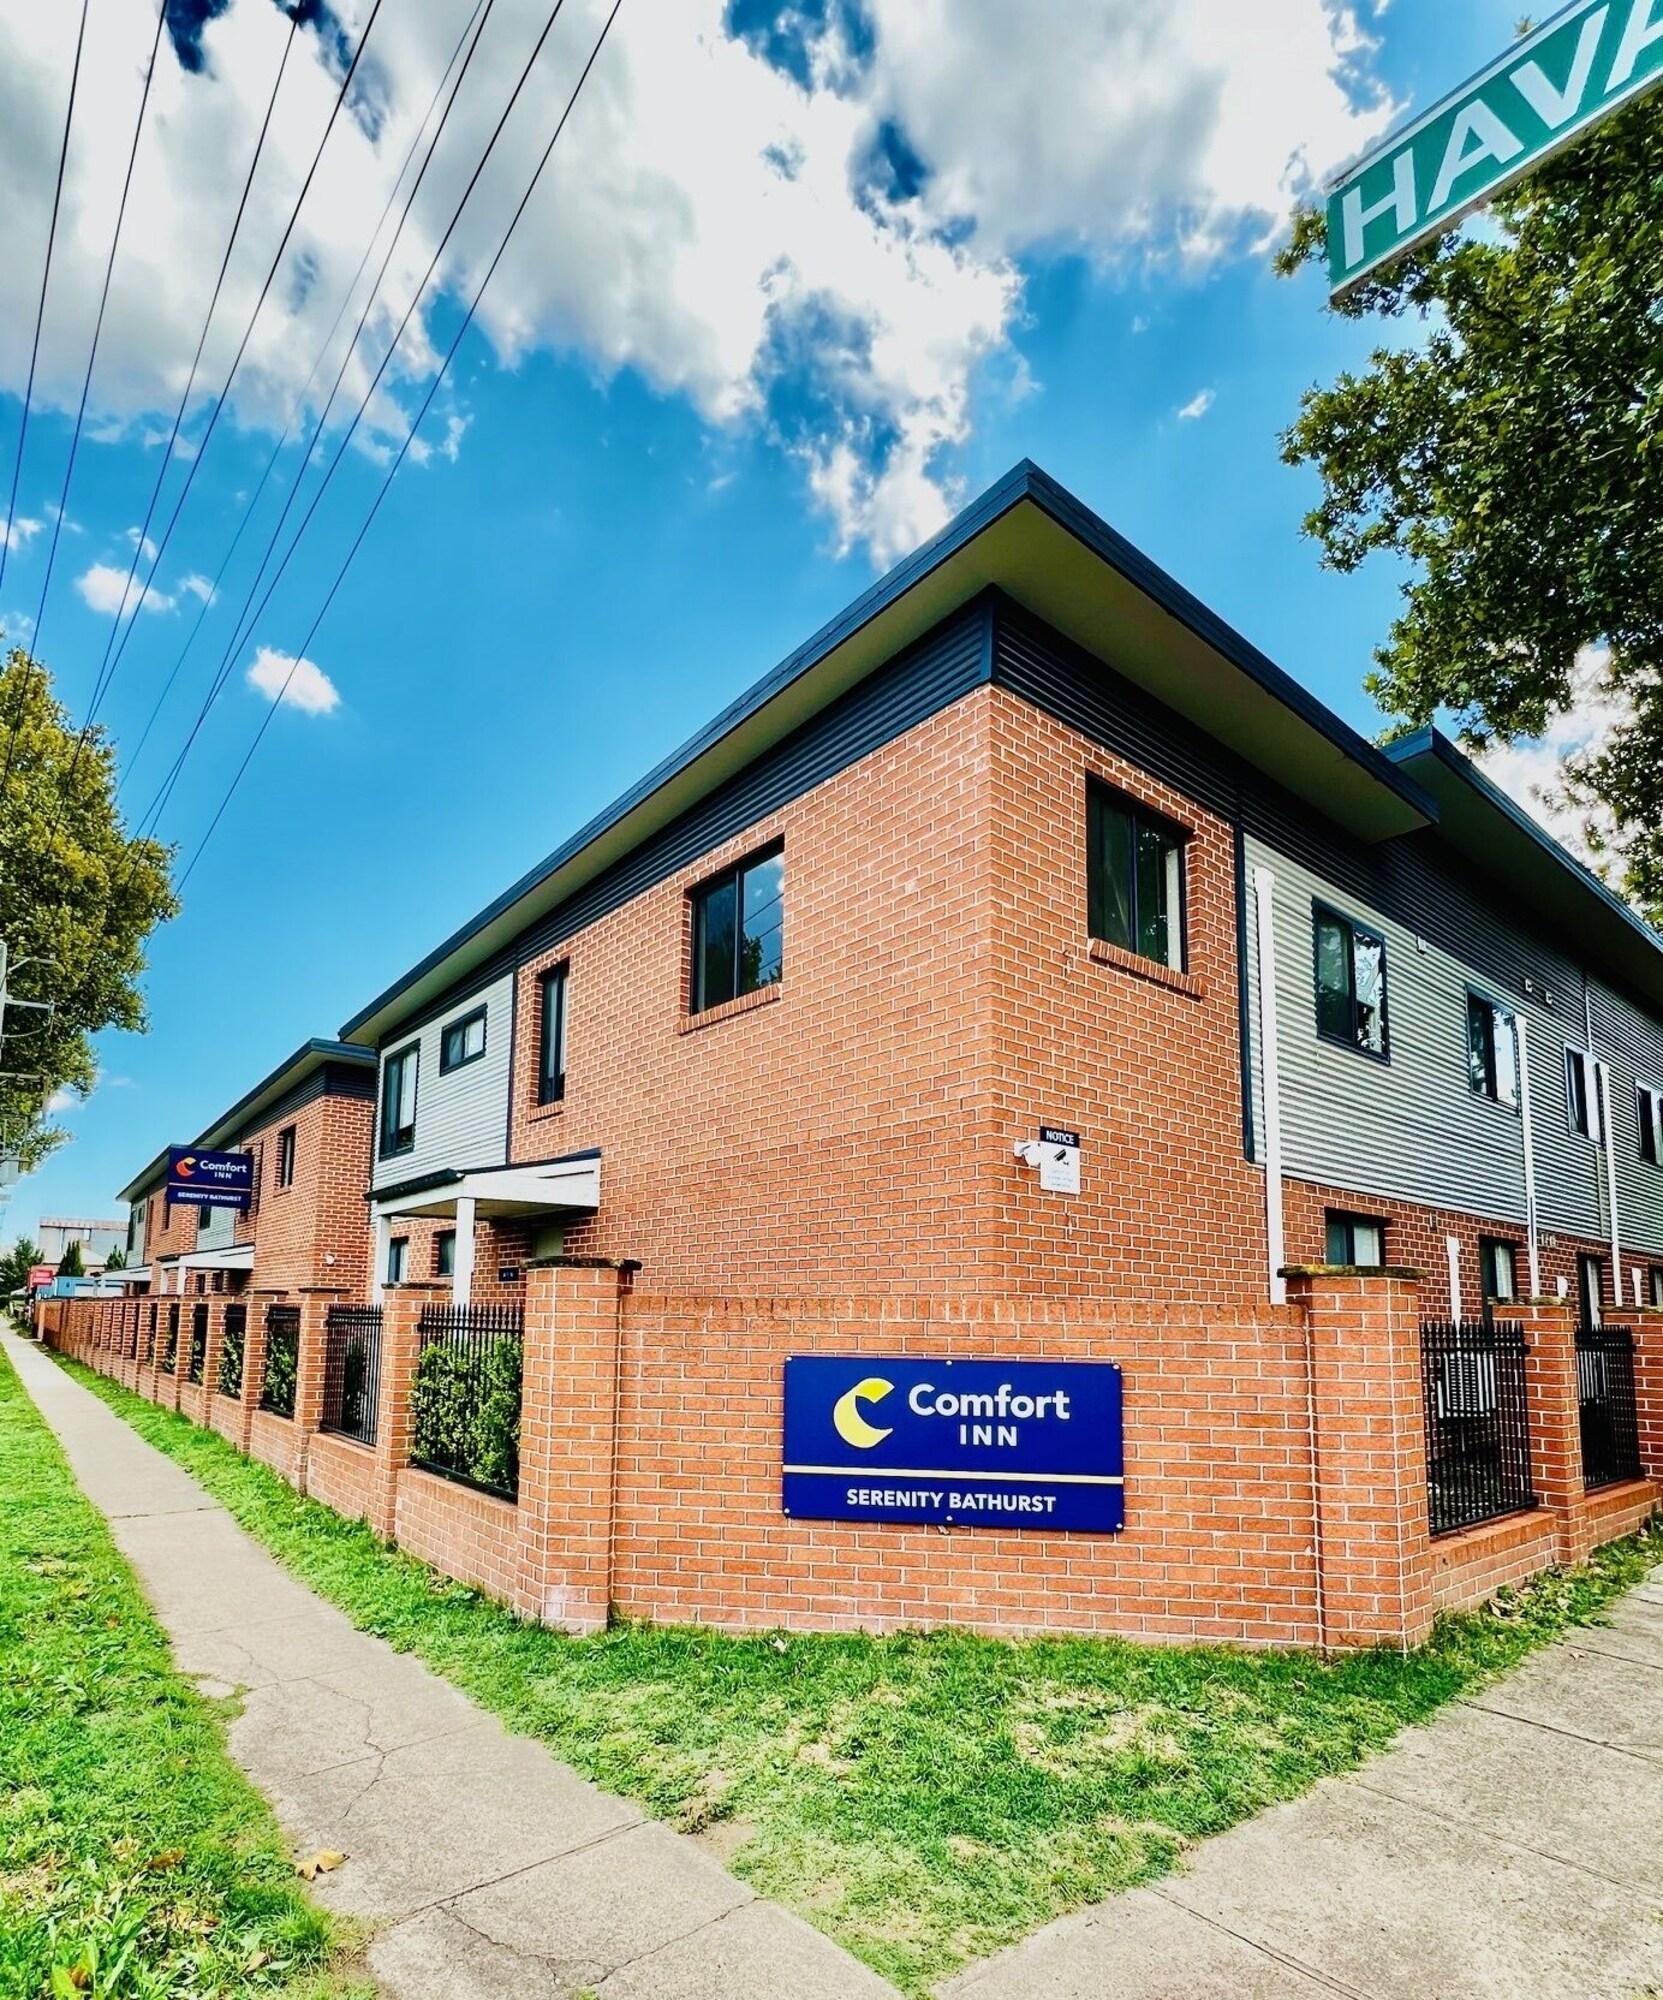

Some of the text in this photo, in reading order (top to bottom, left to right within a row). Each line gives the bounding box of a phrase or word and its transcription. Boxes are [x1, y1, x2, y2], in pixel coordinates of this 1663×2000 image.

[1046, 1130, 1075, 1144] NOTICE
[200, 1160, 247, 1173] Comfort
[214, 1171, 232, 1179] INN
[908, 1383, 1070, 1420] Comfort
[959, 1424, 1017, 1447] INN
[846, 1488, 1056, 1513] SERENITY BATHURST
